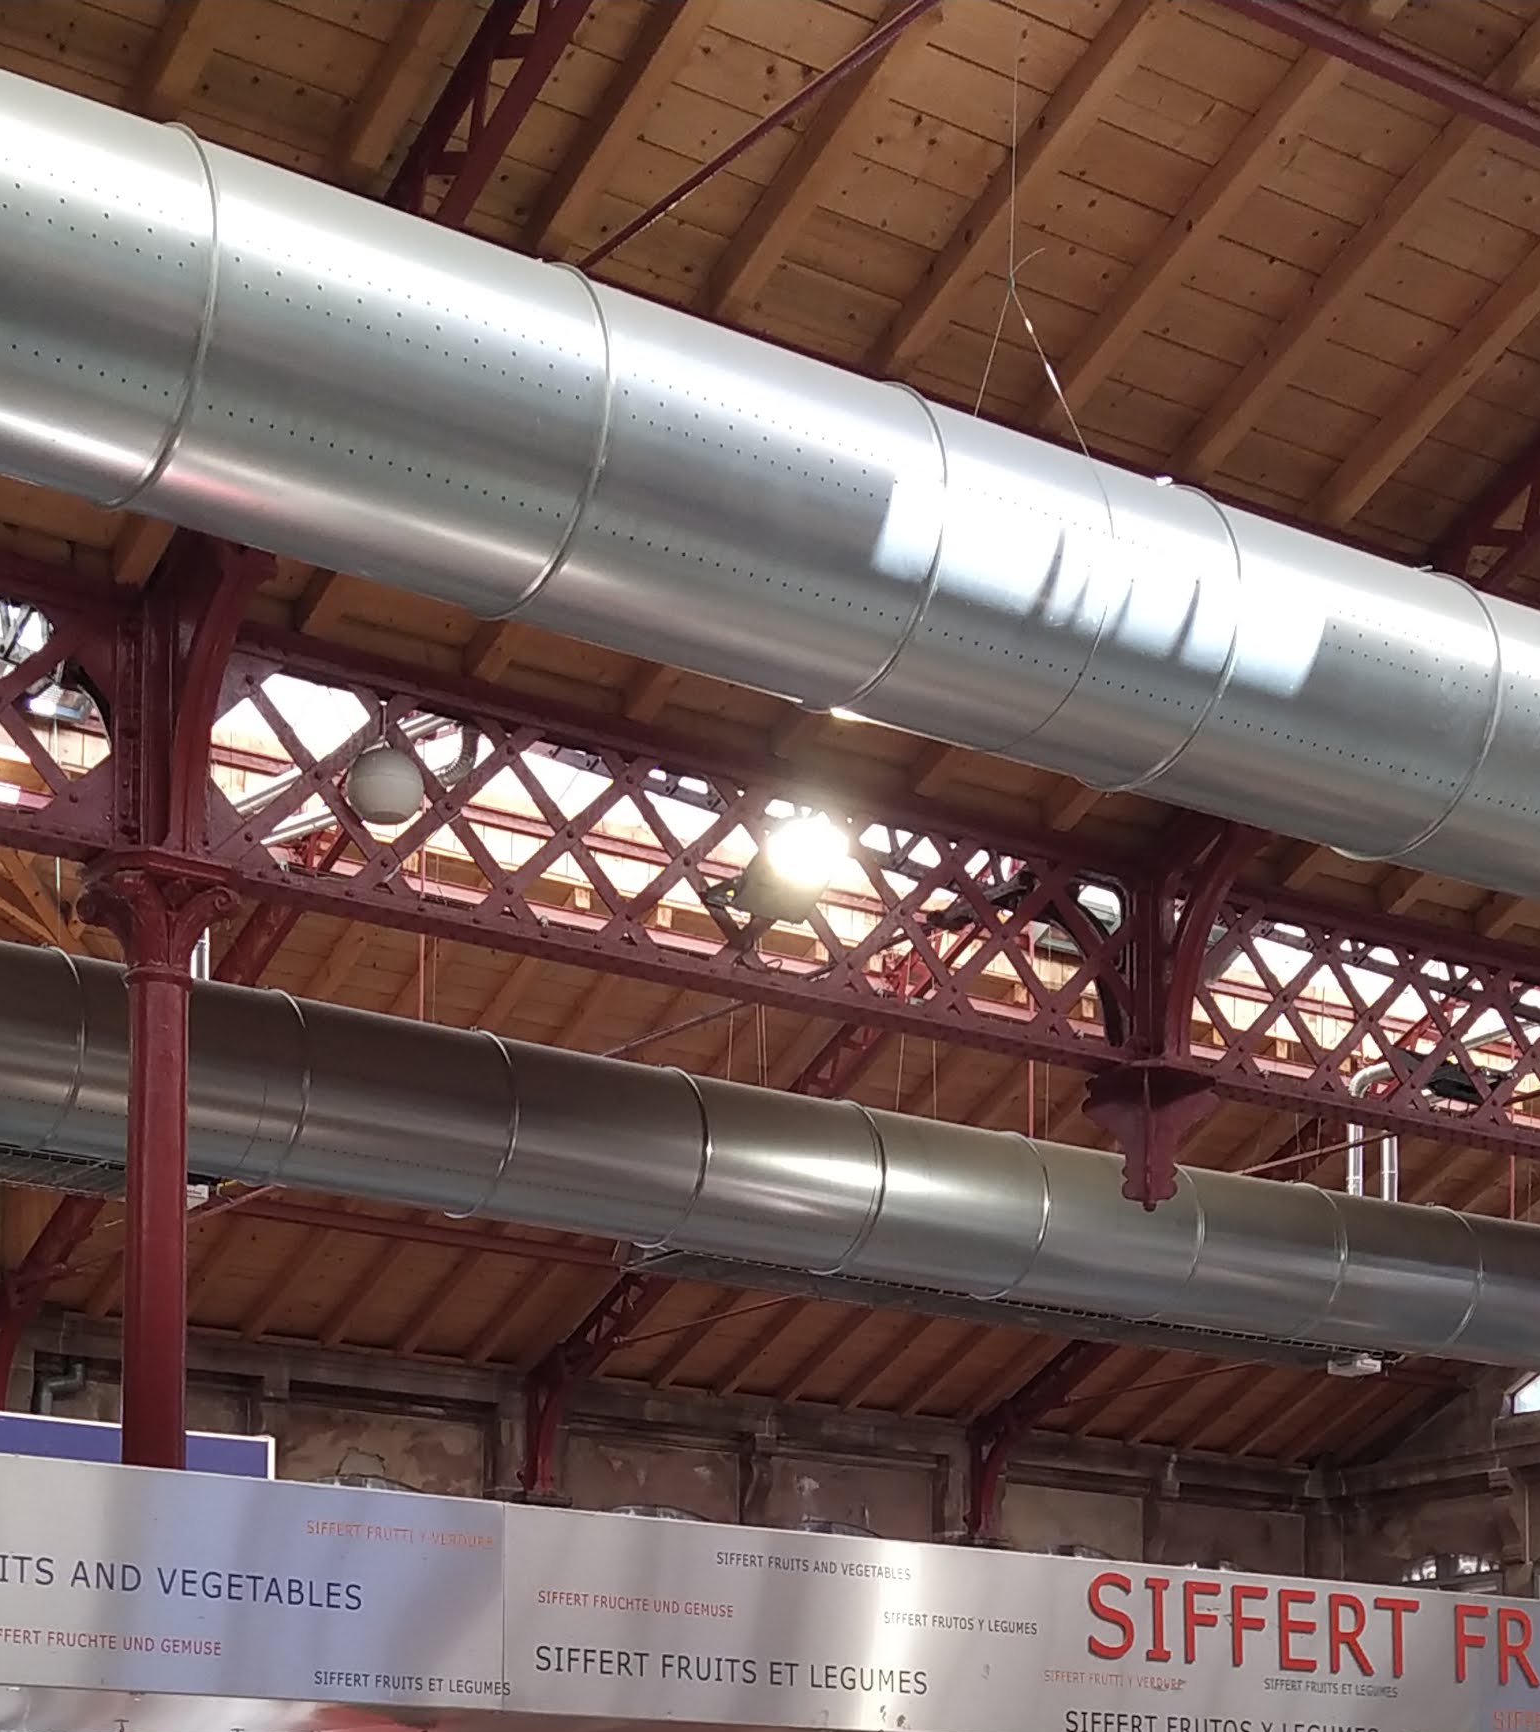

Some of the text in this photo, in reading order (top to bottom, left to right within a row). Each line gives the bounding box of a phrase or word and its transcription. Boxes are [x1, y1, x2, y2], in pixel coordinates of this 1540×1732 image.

[717, 1552, 763, 1567] SIFFERT
[768, 1556, 809, 1572] FRUITS
[841, 1563, 911, 1580] VEGETABLES
[71, 1561, 141, 1591] AND
[158, 1568, 361, 1610] VEGETABLES
[538, 1590, 589, 1606] SIFFERT
[594, 1595, 648, 1611] FRUCHTE
[685, 1602, 733, 1618] GEMUSE
[1088, 1573, 1418, 1679] SIFFERT
[48, 1631, 116, 1649] FRUCHTE
[123, 1637, 154, 1652] UND
[161, 1639, 221, 1656] GEMUSE
[314, 1671, 370, 1687] SIFFERT
[375, 1675, 423, 1691] FRUITS
[448, 1675, 512, 1697] LEGUMES
[536, 1646, 927, 1695] SIFFERT FRUITS ET LEGUMES
